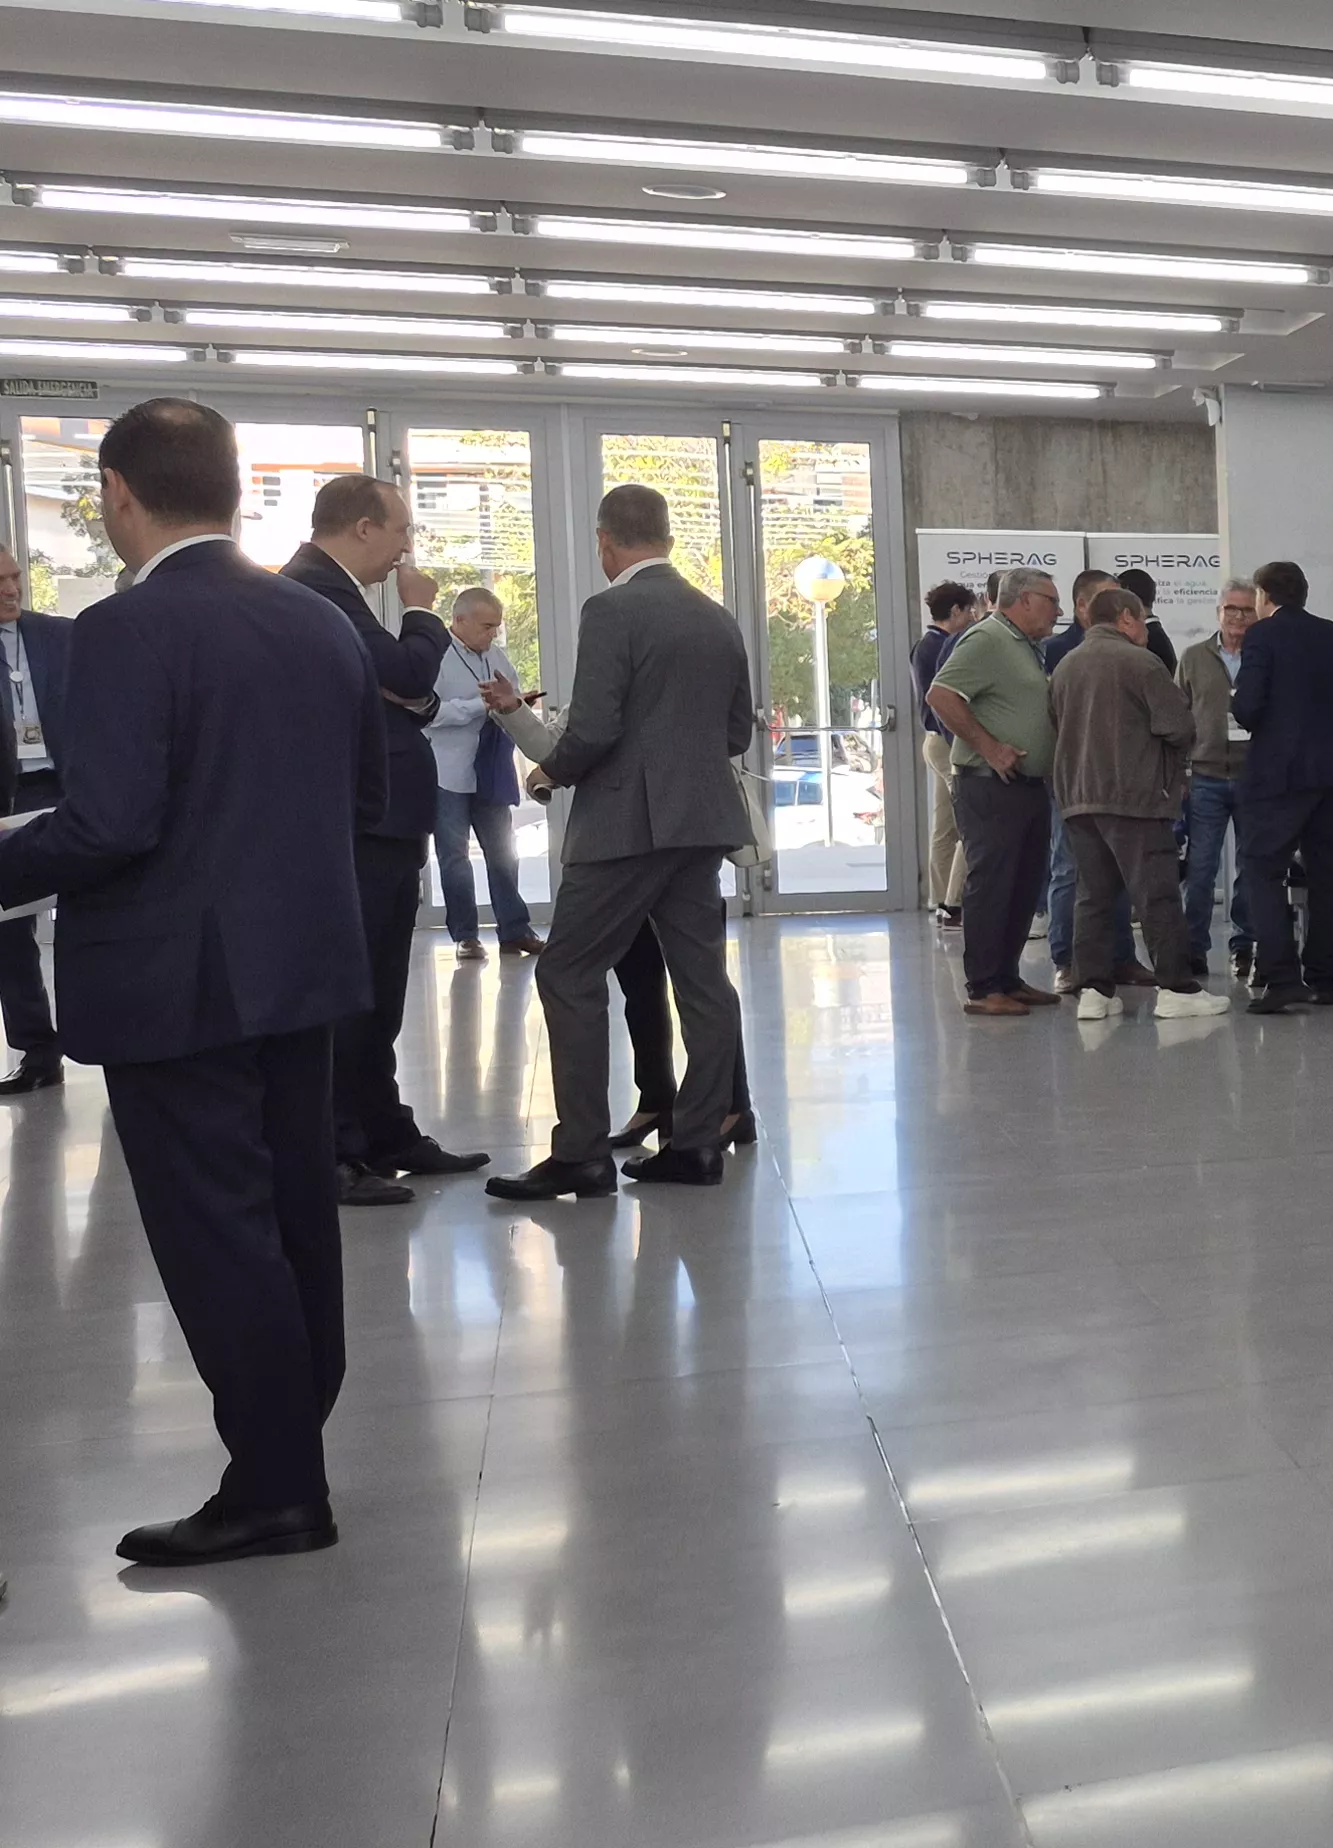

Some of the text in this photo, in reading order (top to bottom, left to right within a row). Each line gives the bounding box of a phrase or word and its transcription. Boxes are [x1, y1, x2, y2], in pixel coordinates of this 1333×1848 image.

[946, 552, 1057, 566] SPHERAG
[1114, 554, 1220, 568] SPHERAG
[1173, 588, 1218, 596] eficiencia
